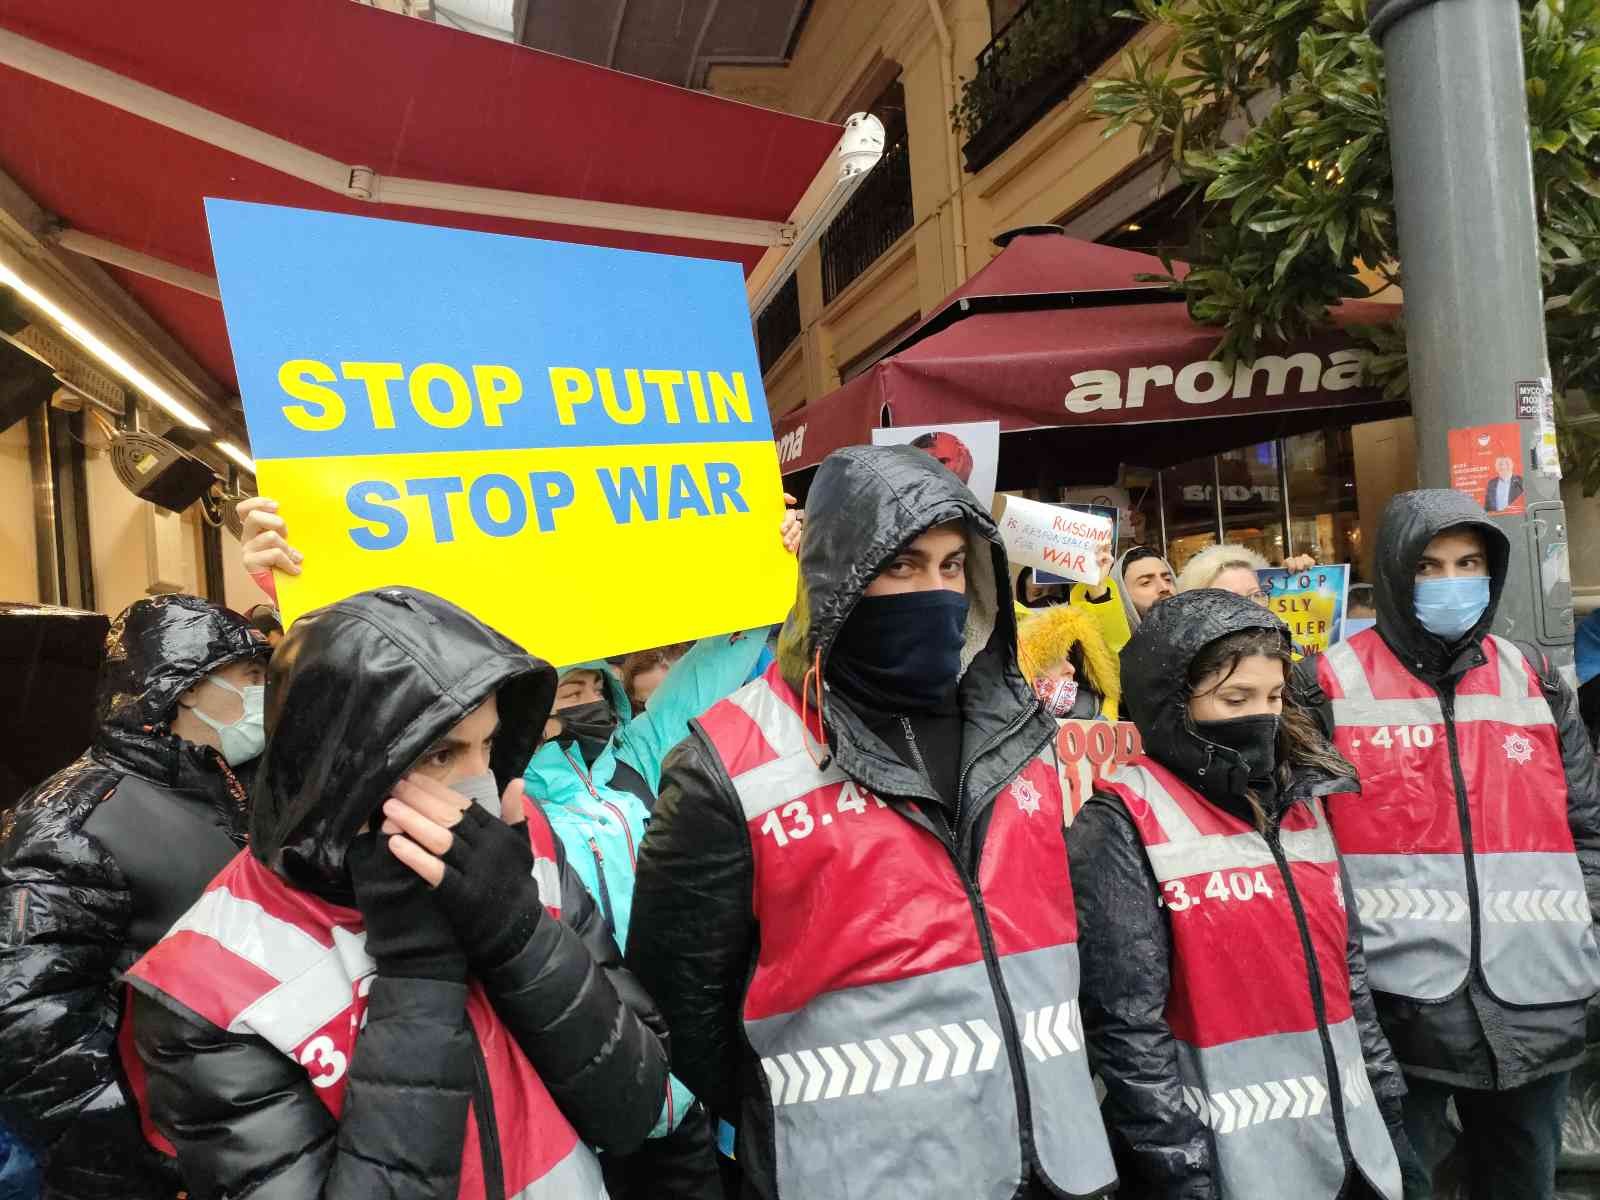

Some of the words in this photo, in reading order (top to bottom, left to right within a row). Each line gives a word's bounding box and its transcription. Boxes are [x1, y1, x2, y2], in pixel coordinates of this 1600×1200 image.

[278, 359, 523, 431] STOP
[548, 366, 753, 426] PUTIN
[1065, 349, 1364, 414] aroma
[775, 424, 806, 464] ma
[345, 473, 575, 551] STOP
[596, 462, 750, 525] WAR
[1043, 546, 1086, 573] WAR
[1267, 574, 1327, 590] STOP
[1158, 871, 1273, 912] 3.404
